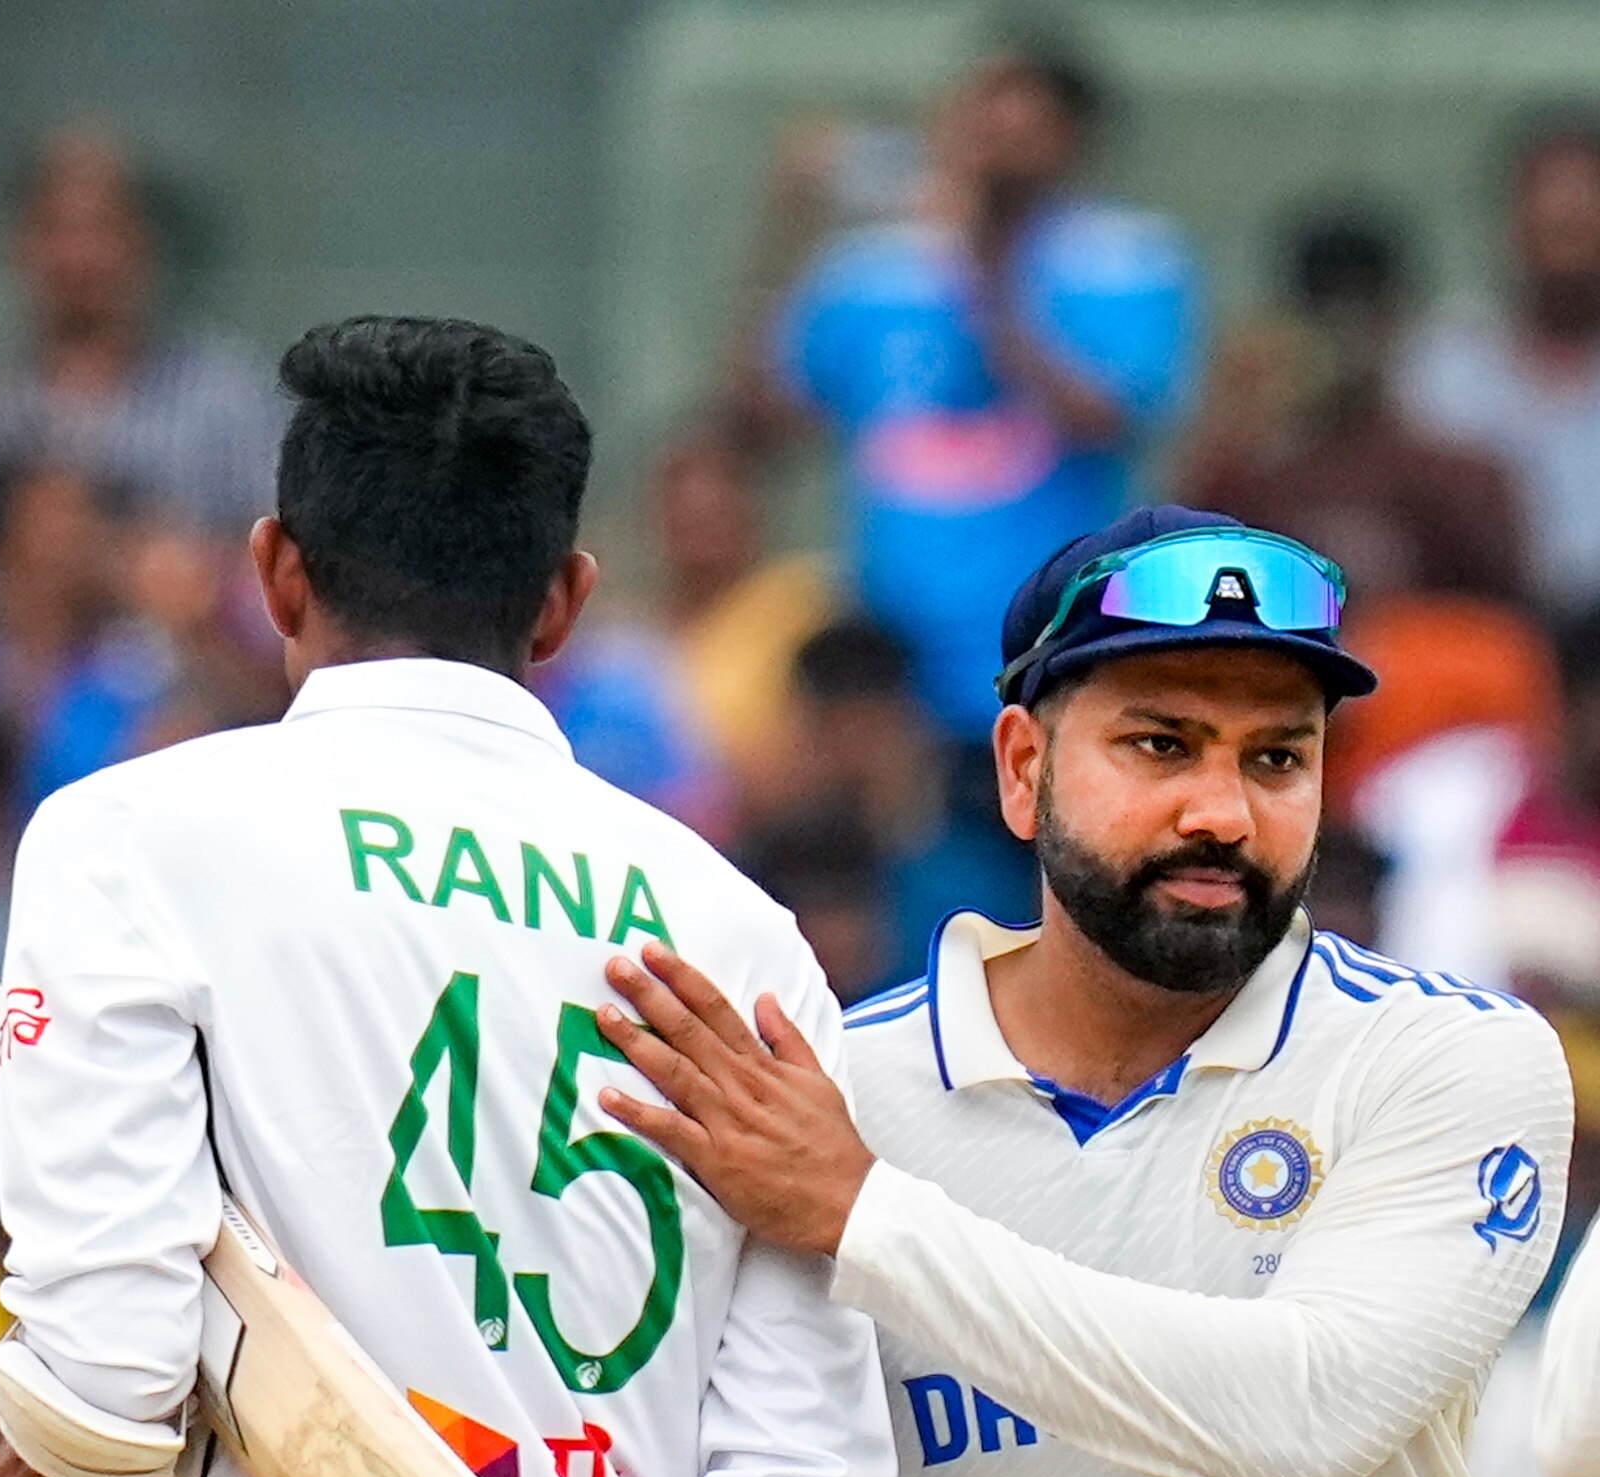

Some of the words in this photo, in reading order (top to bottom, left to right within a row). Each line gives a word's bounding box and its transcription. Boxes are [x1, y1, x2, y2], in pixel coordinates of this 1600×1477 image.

[339, 808, 680, 957] RANA
[381, 971, 685, 1395] 45
[1252, 1252, 1282, 1275] 28
